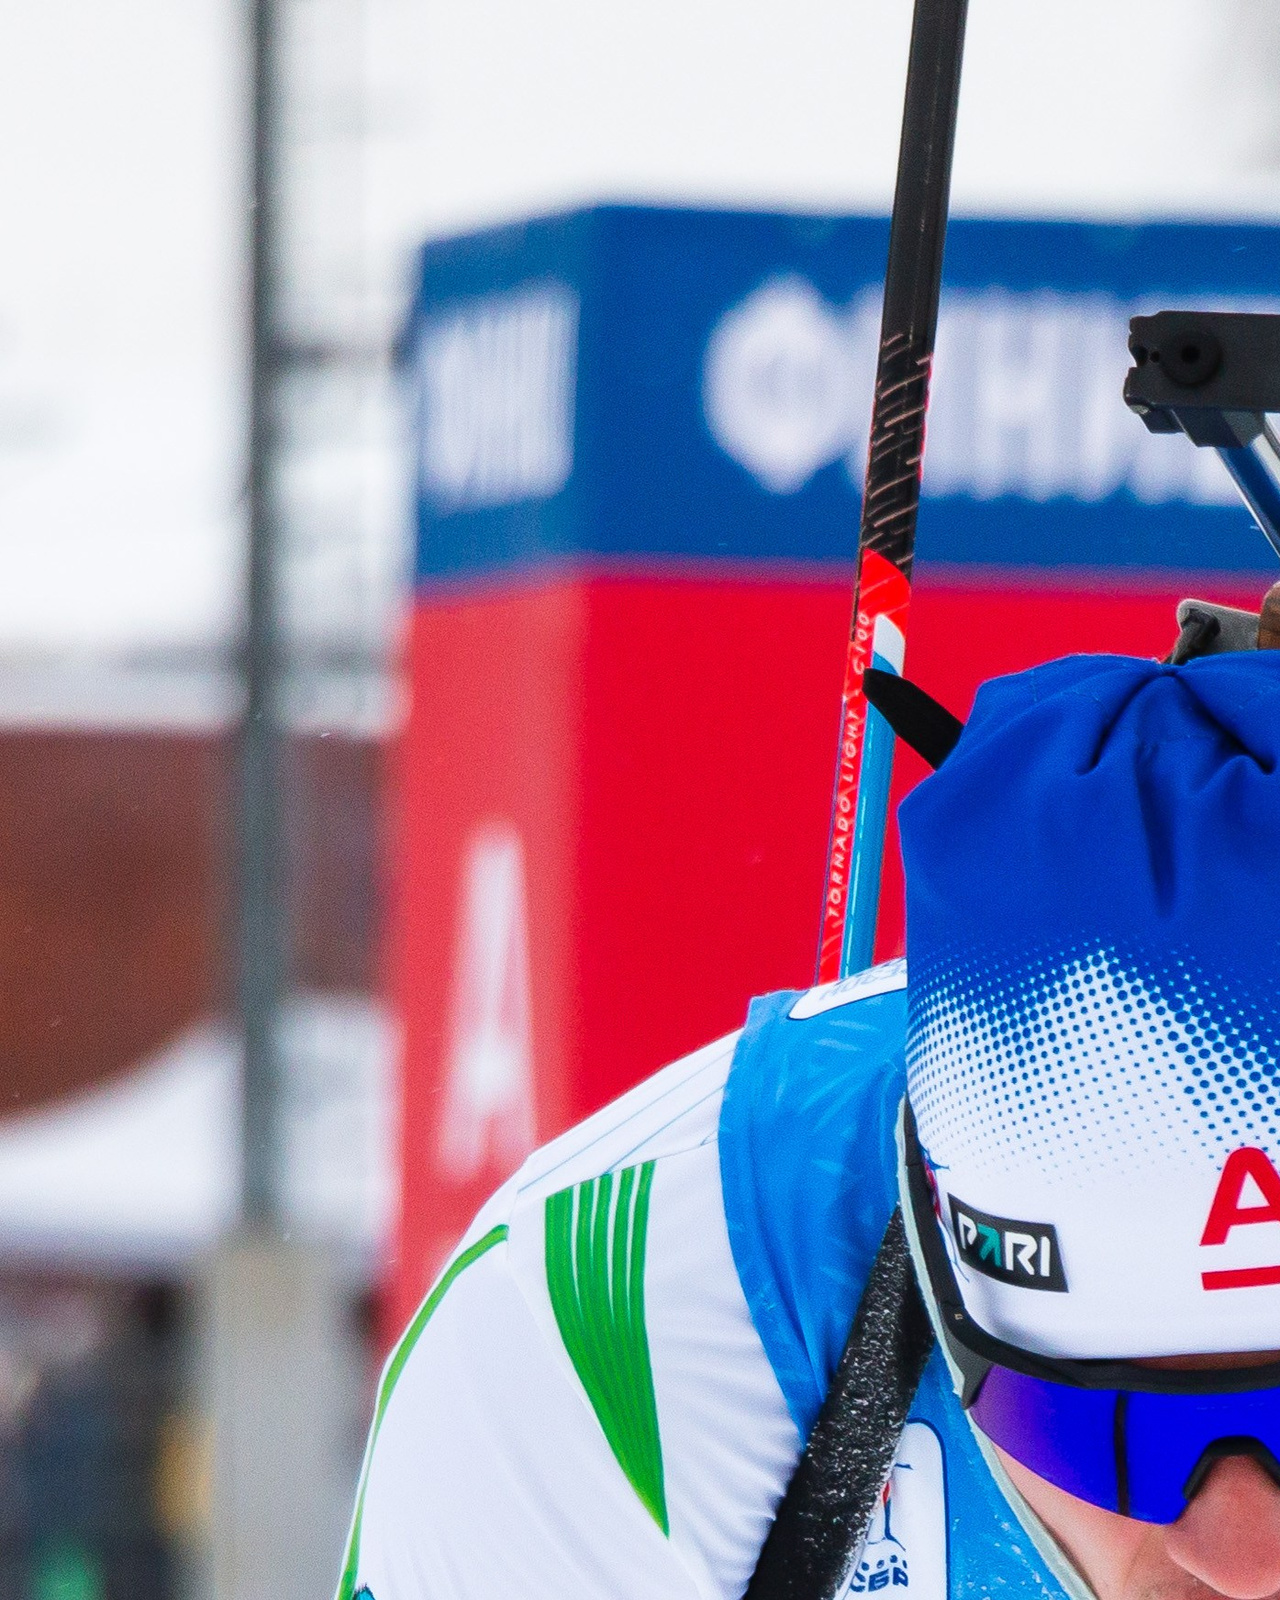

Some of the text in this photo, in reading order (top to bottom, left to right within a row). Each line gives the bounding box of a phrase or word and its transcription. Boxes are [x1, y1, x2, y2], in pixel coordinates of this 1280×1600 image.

[828, 796, 852, 918] TORNADO
[842, 708, 860, 784] LIGHT
[956, 1211, 1052, 1278] PARI
